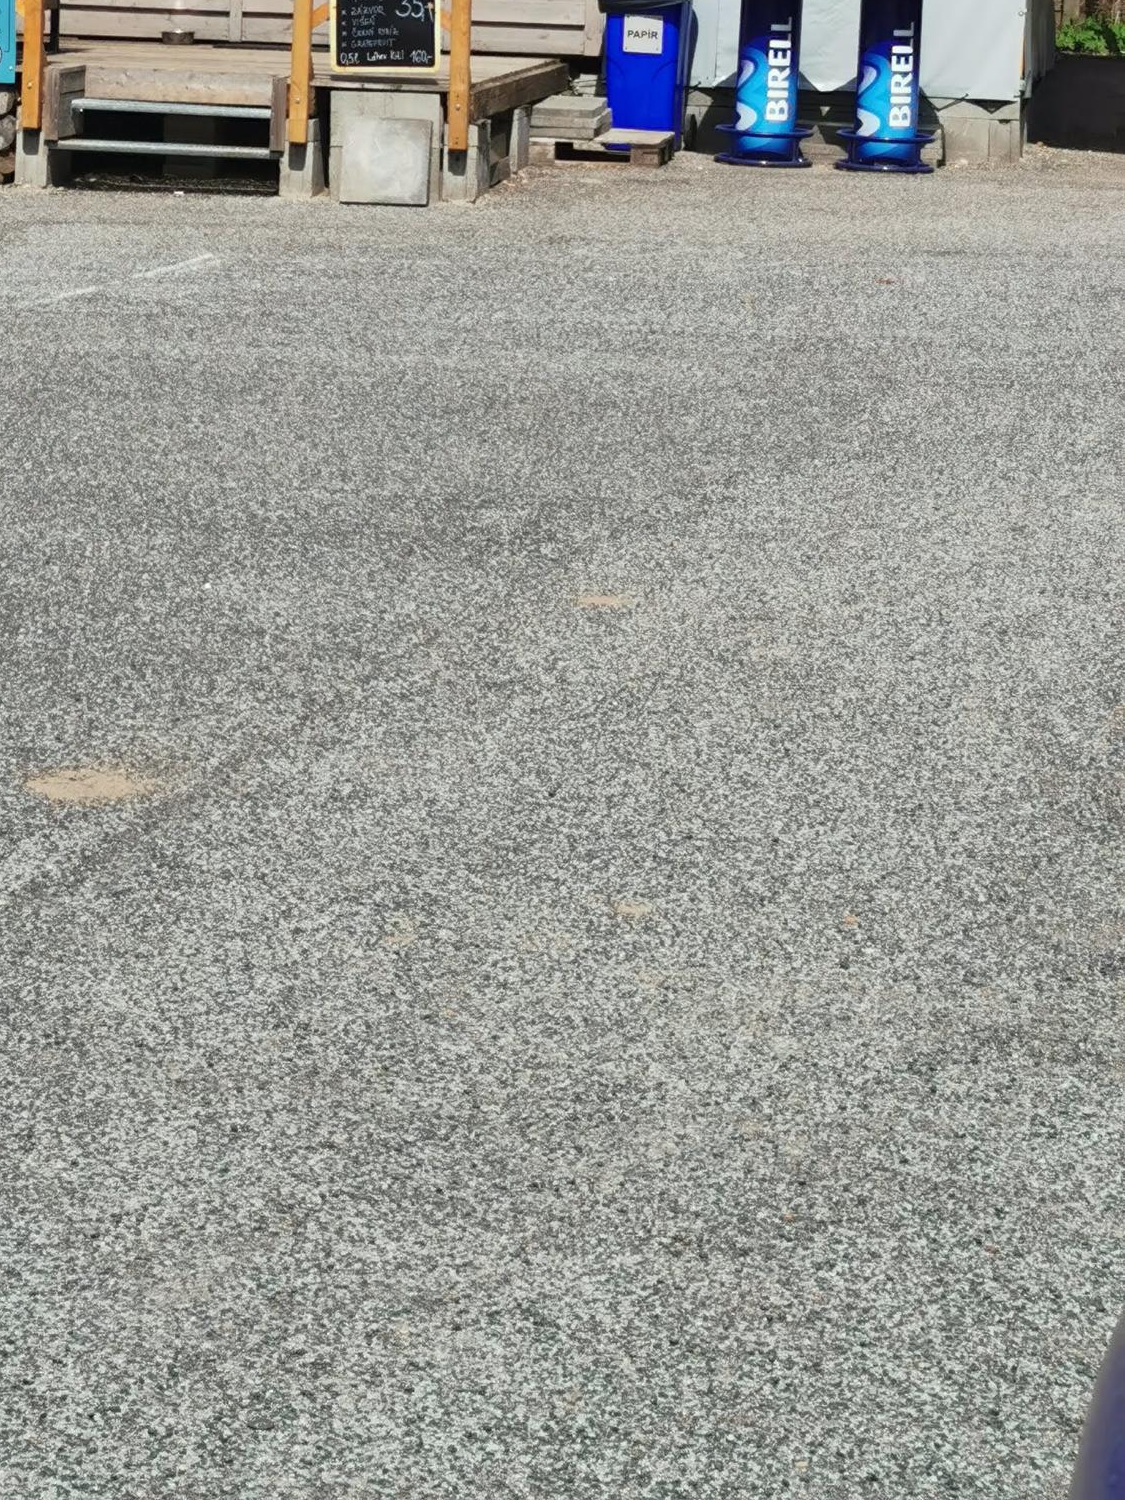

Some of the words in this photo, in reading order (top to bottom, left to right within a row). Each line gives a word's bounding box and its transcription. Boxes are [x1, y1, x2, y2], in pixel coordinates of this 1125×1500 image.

[627, 29, 659, 40] PAPÍR
[764, 16, 792, 121] BIRELL
[888, 21, 915, 128] BIRELL
